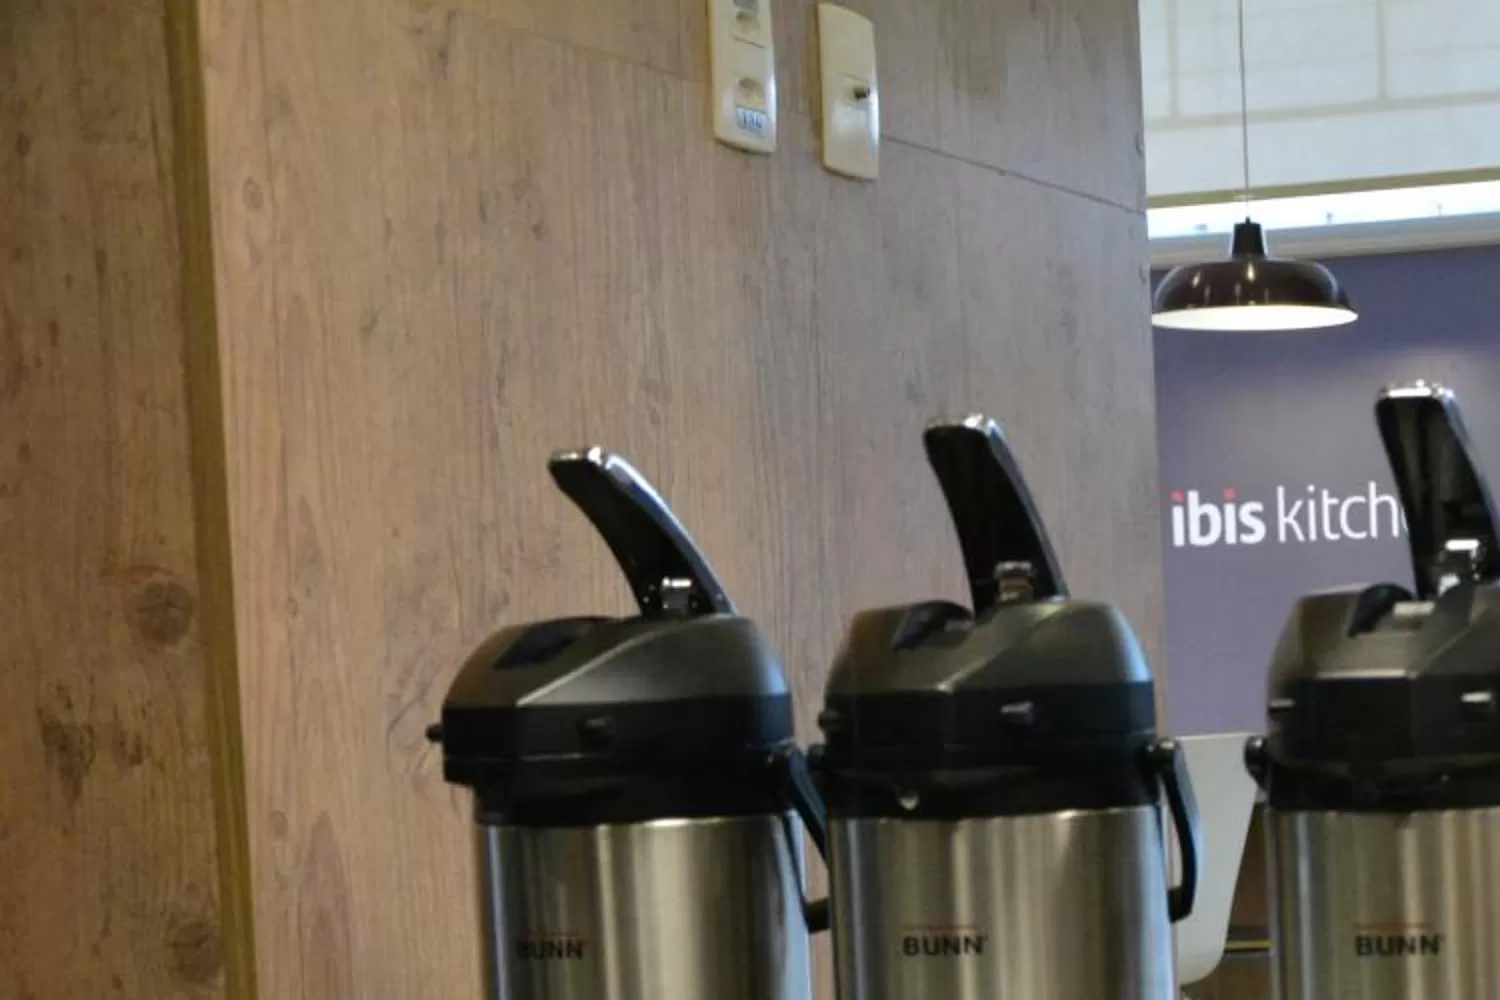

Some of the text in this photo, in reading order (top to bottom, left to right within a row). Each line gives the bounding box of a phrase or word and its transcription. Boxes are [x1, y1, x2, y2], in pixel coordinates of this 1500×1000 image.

[1170, 480, 1408, 547] ibis kitch
[903, 935, 984, 957] BUNN
[1354, 933, 1441, 957] BUNN
